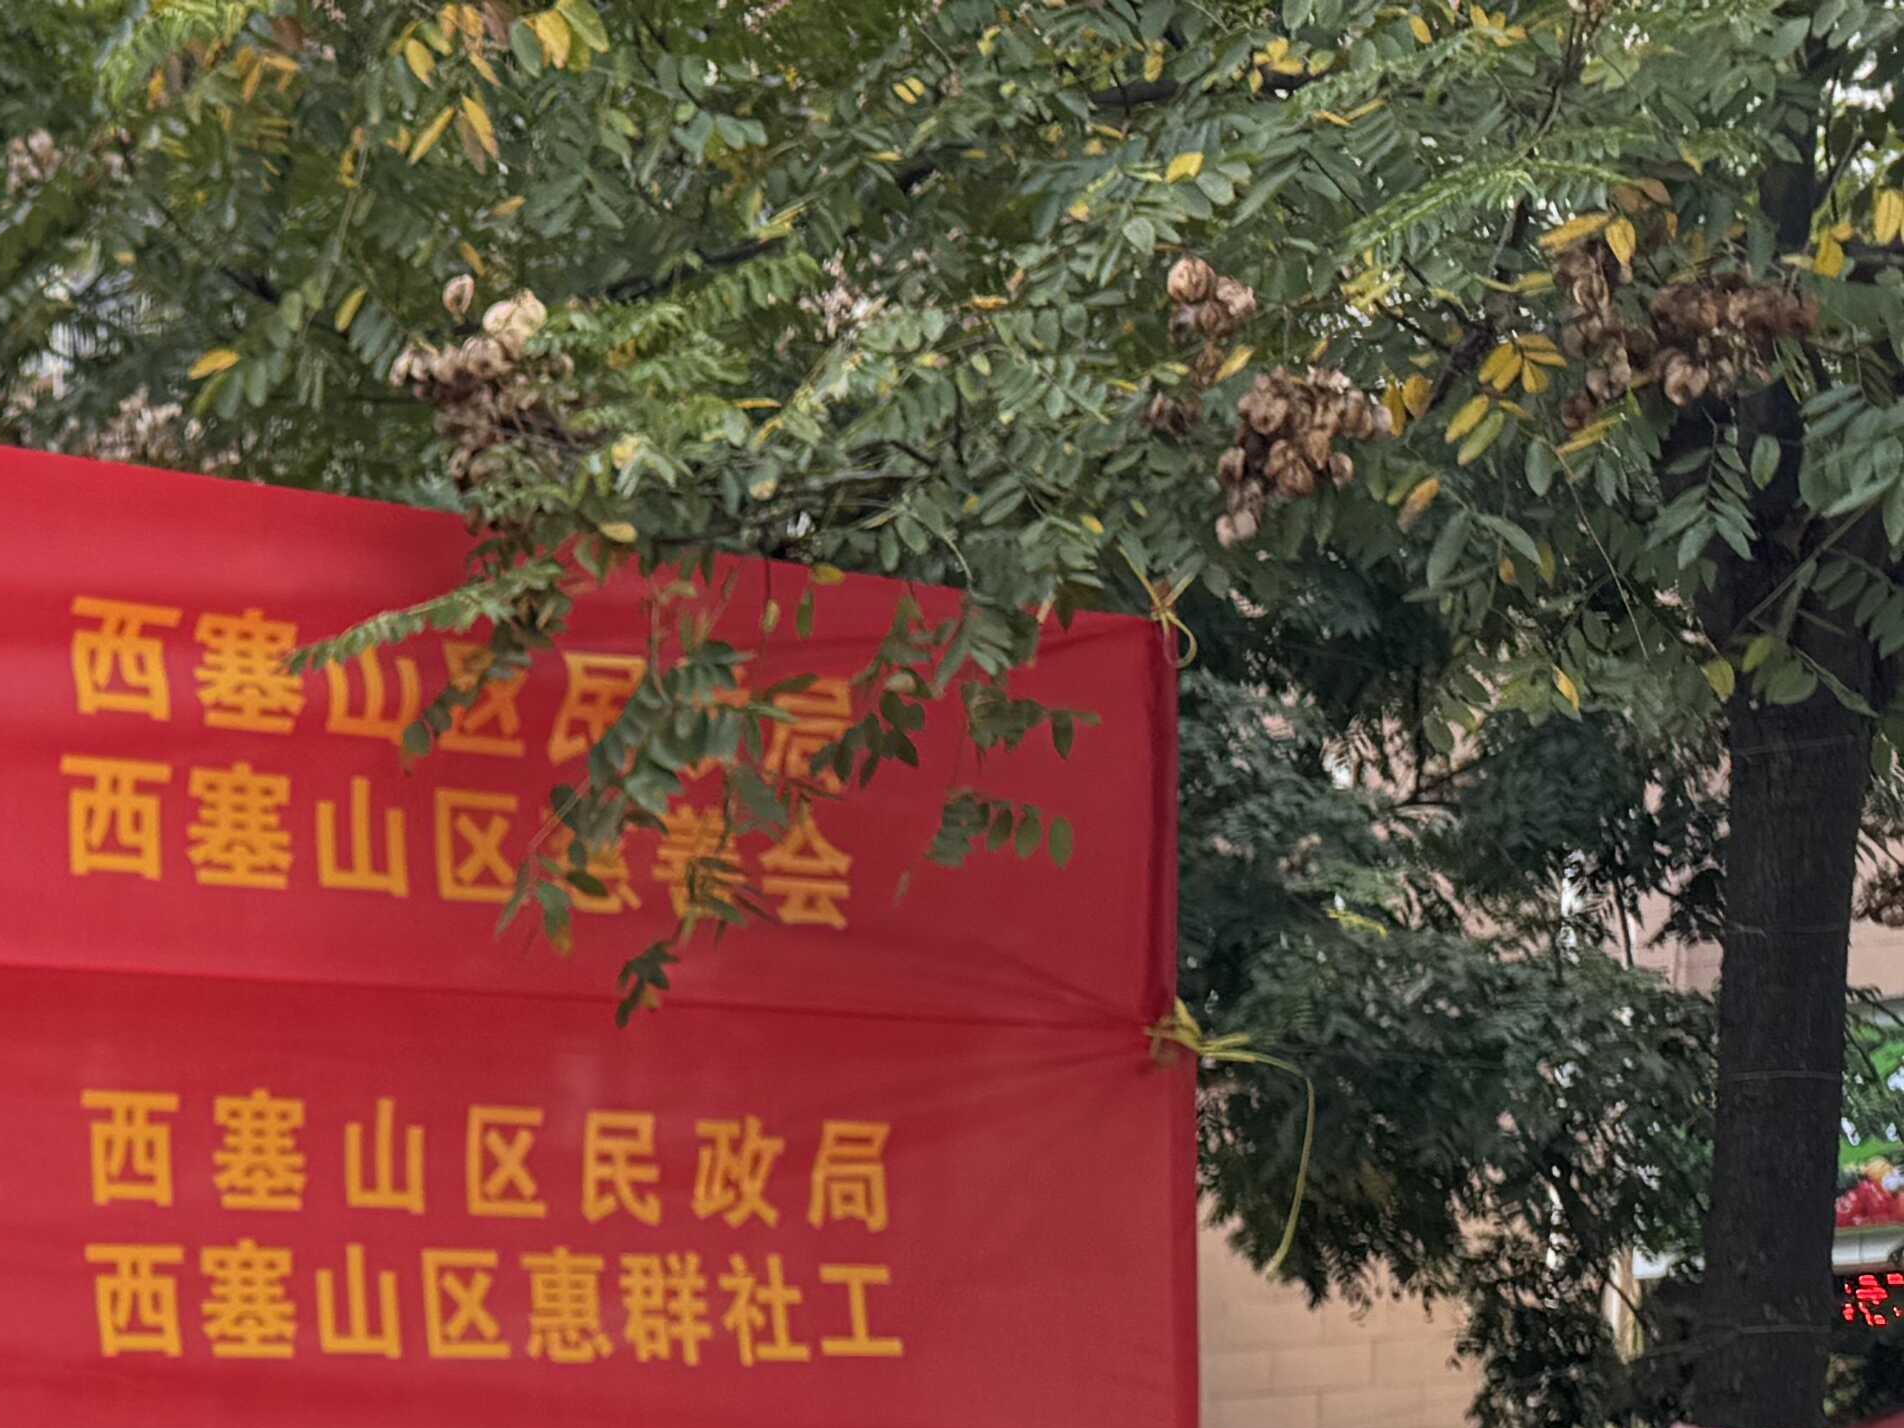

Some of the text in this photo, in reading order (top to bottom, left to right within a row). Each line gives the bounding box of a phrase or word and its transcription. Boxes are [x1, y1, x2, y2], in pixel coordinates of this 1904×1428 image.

[71, 595, 853, 793] 西塞山区民局
[80, 1086, 892, 1232] 西塞山区民政局
[84, 1238, 904, 1366] 西塞山区惠群社工
